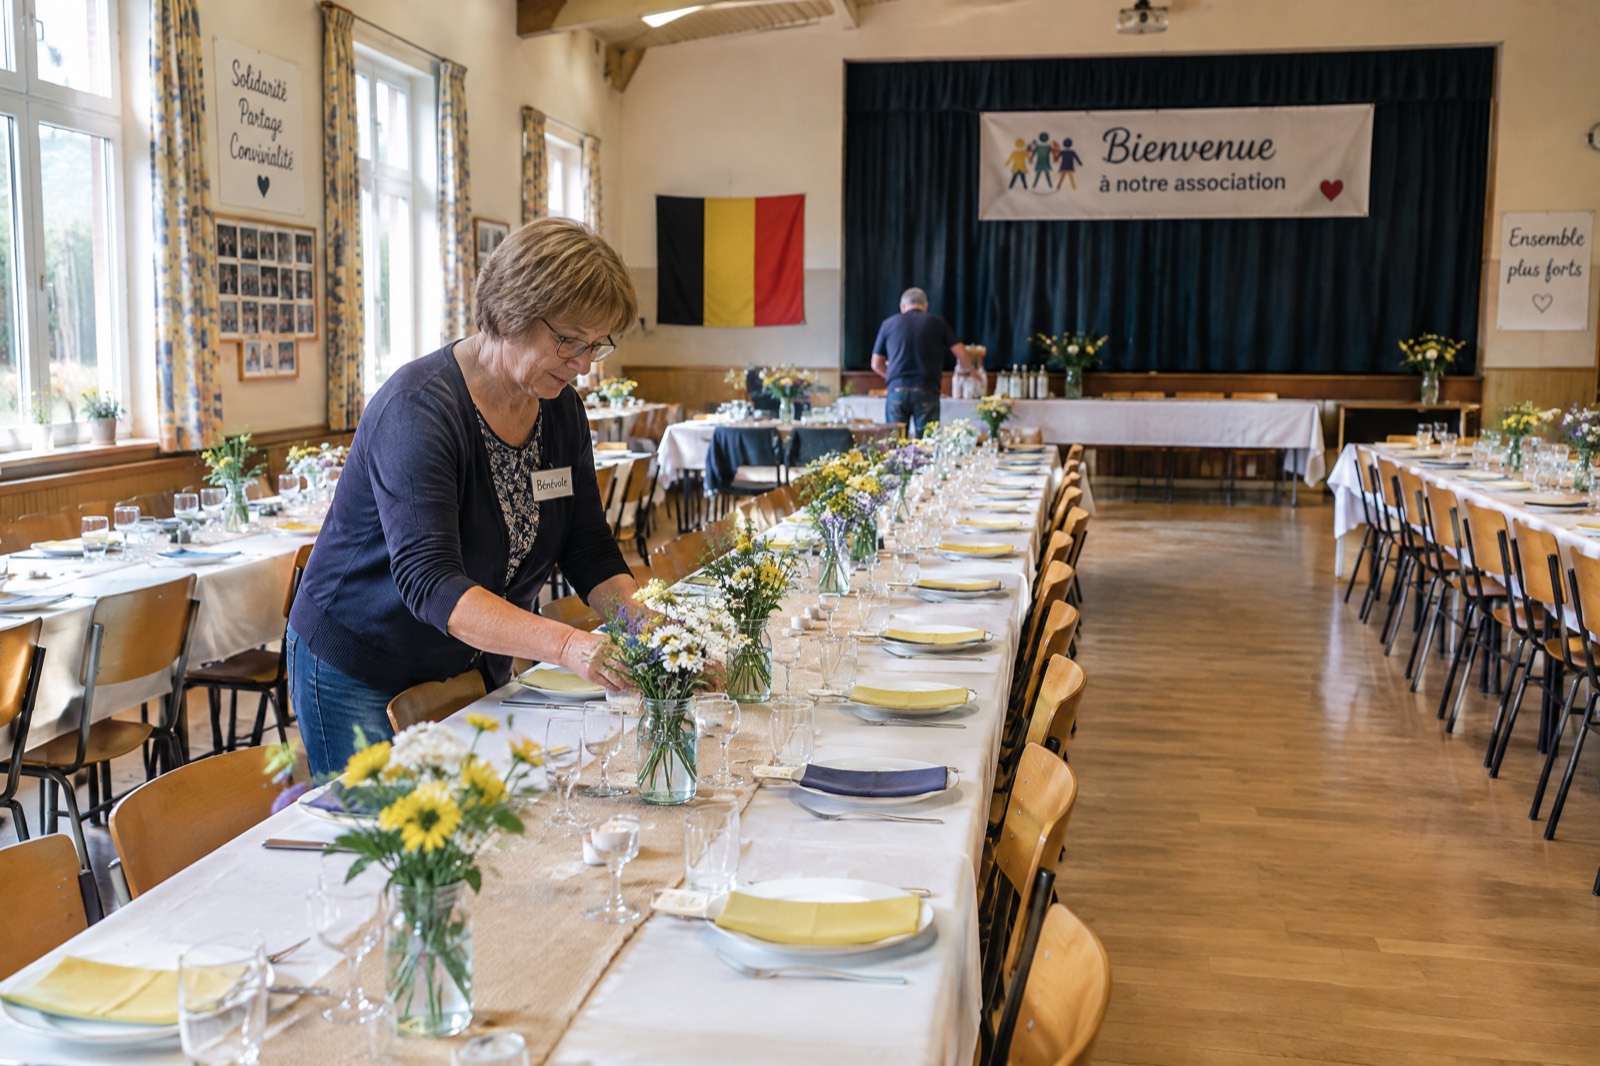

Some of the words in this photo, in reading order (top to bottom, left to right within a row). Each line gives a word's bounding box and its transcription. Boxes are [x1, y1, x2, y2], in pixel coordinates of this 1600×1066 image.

[232, 59, 287, 102] Solidarité
[239, 97, 283, 141] Partage
[230, 132, 293, 171] Convivialité
[1102, 127, 1277, 164] Bienvenue
[1099, 174, 1111, 193] à
[1116, 175, 1169, 193] notre
[1174, 172, 1286, 192] association
[1509, 227, 1584, 247] Ensemble
[1507, 258, 1540, 284] plus
[1545, 258, 1582, 283] forts
